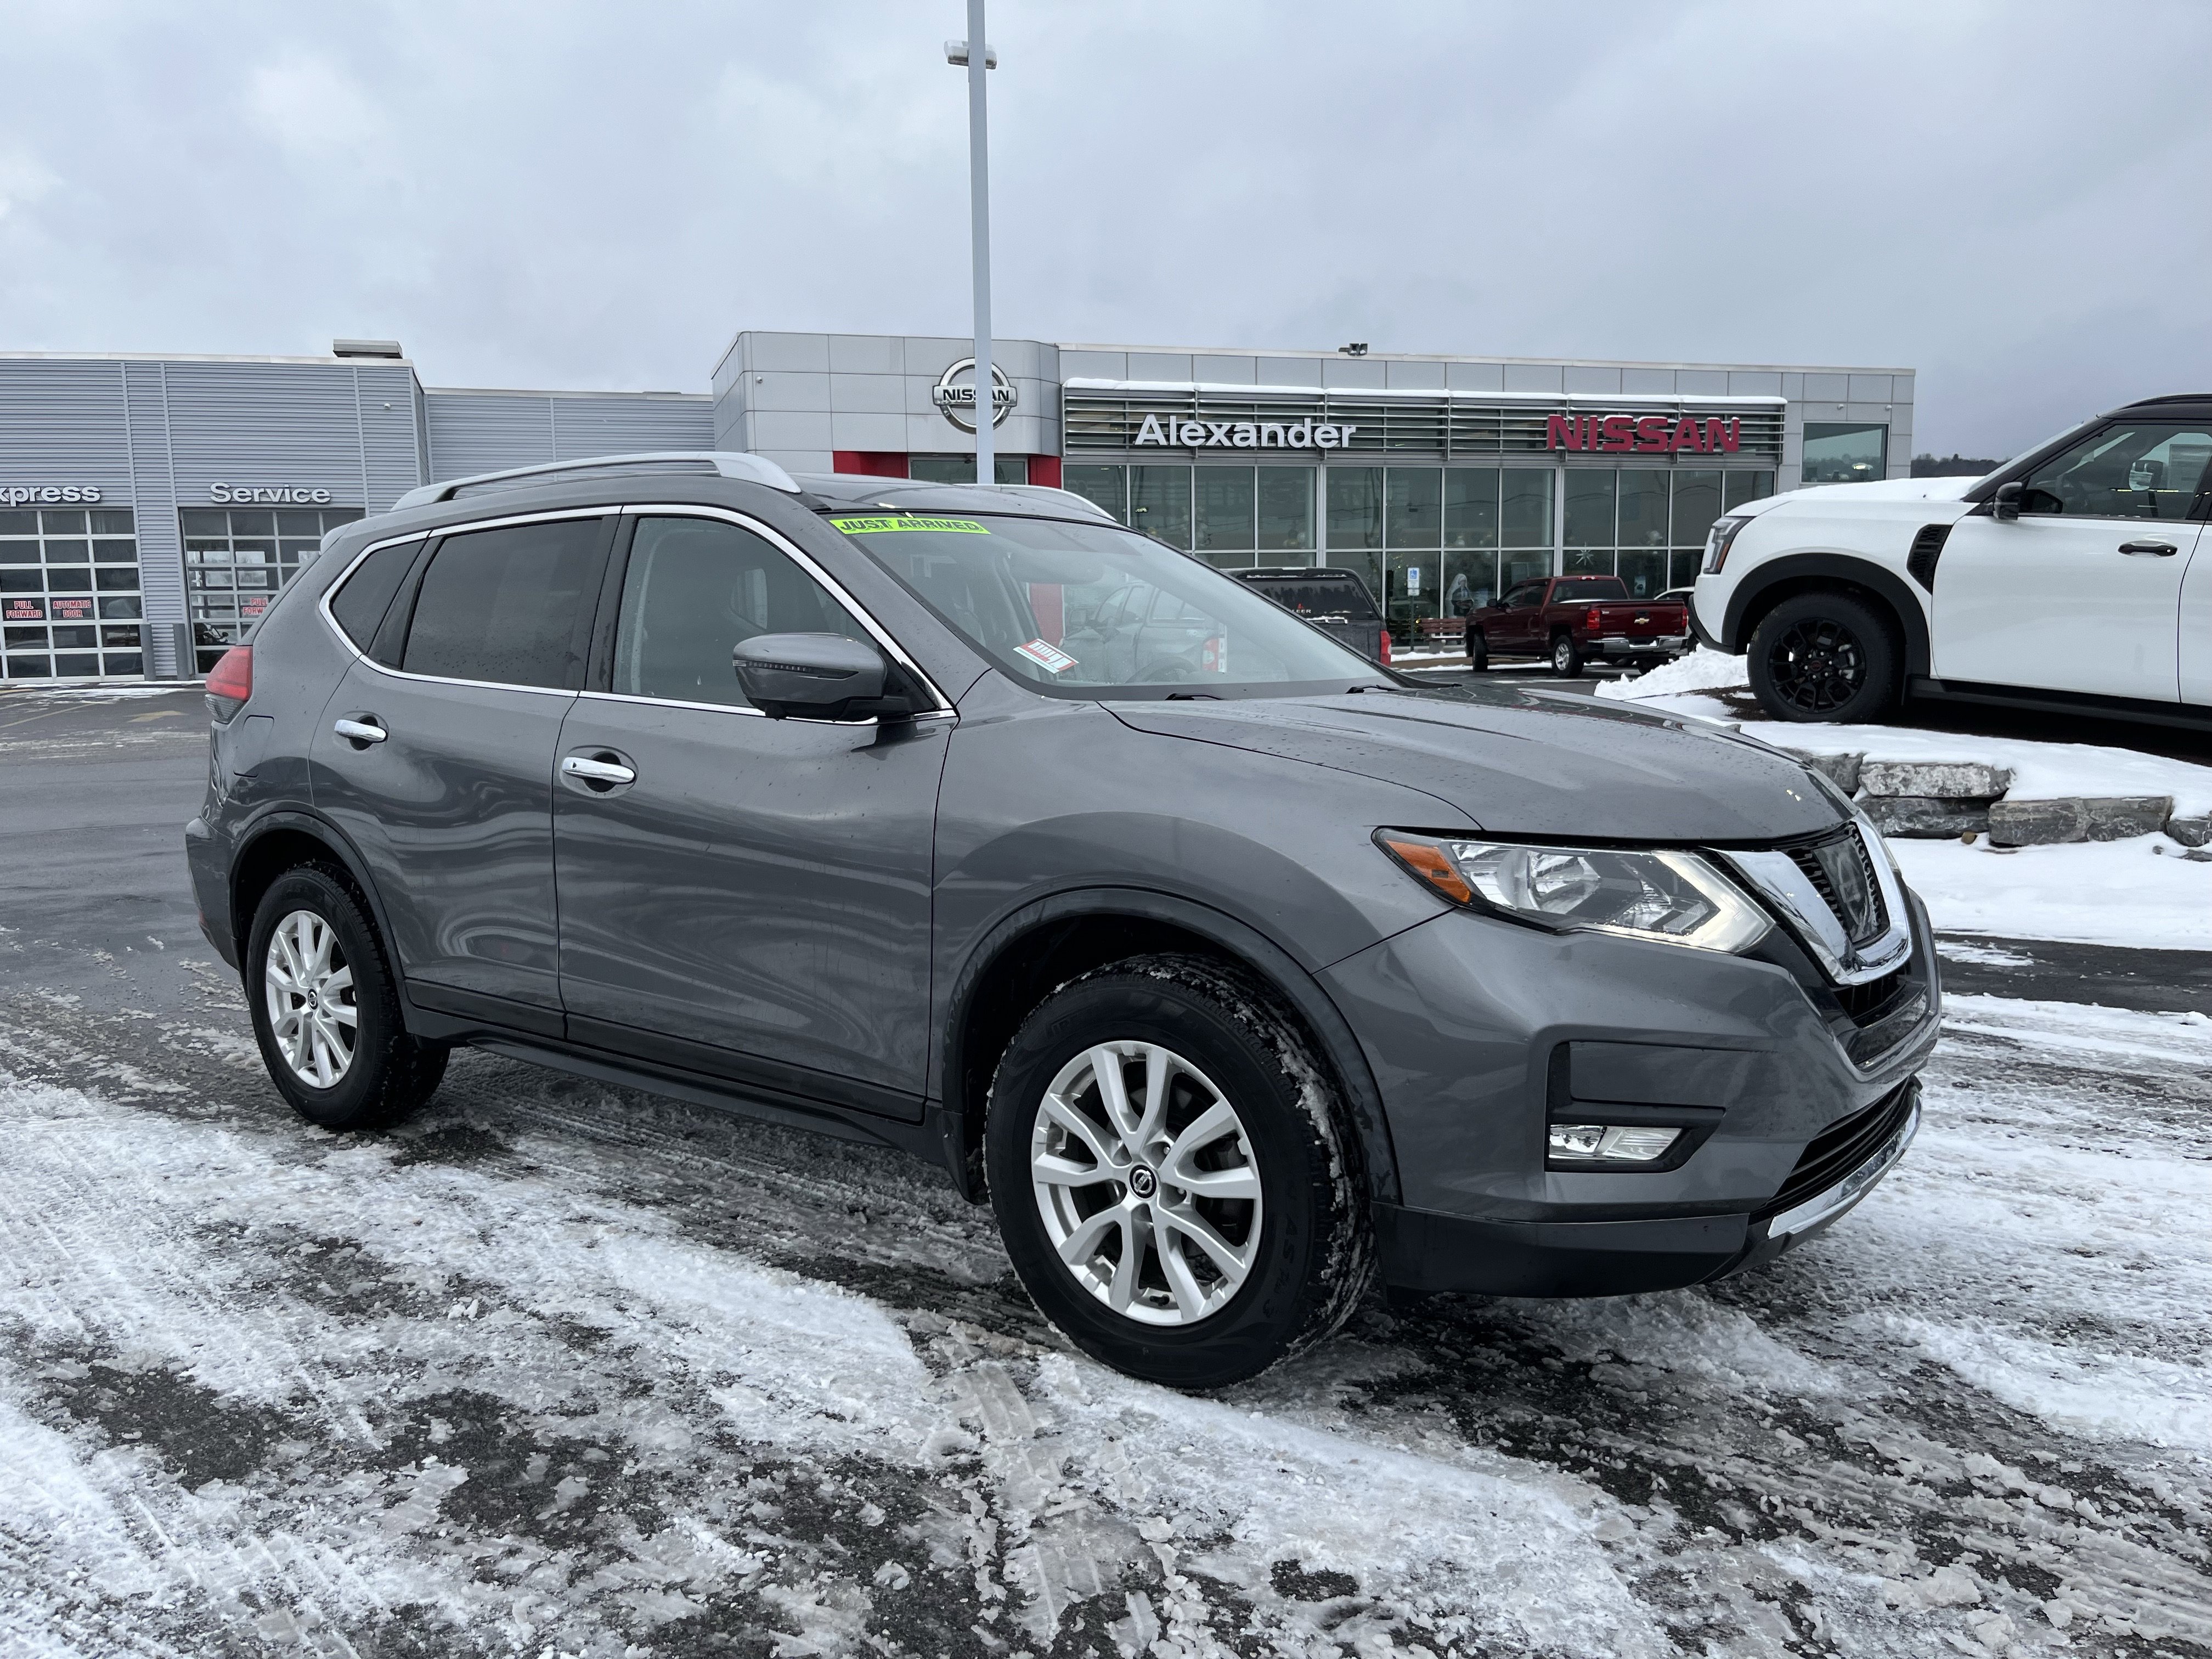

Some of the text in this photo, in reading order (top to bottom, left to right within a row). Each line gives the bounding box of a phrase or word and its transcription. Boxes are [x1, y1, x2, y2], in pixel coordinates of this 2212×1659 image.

[943, 388, 1009, 402] NISN
[1134, 414, 1356, 449] Alexander
[1547, 414, 1740, 453] NISSAN
[210, 482, 331, 503] Service
[840, 519, 984, 532] JUST ARRIVED
[14, 601, 33, 609] PULL
[53, 600, 92, 609] AUTOMATIC
[6, 610, 43, 618] FORWARD
[63, 610, 83, 618] DOOR
